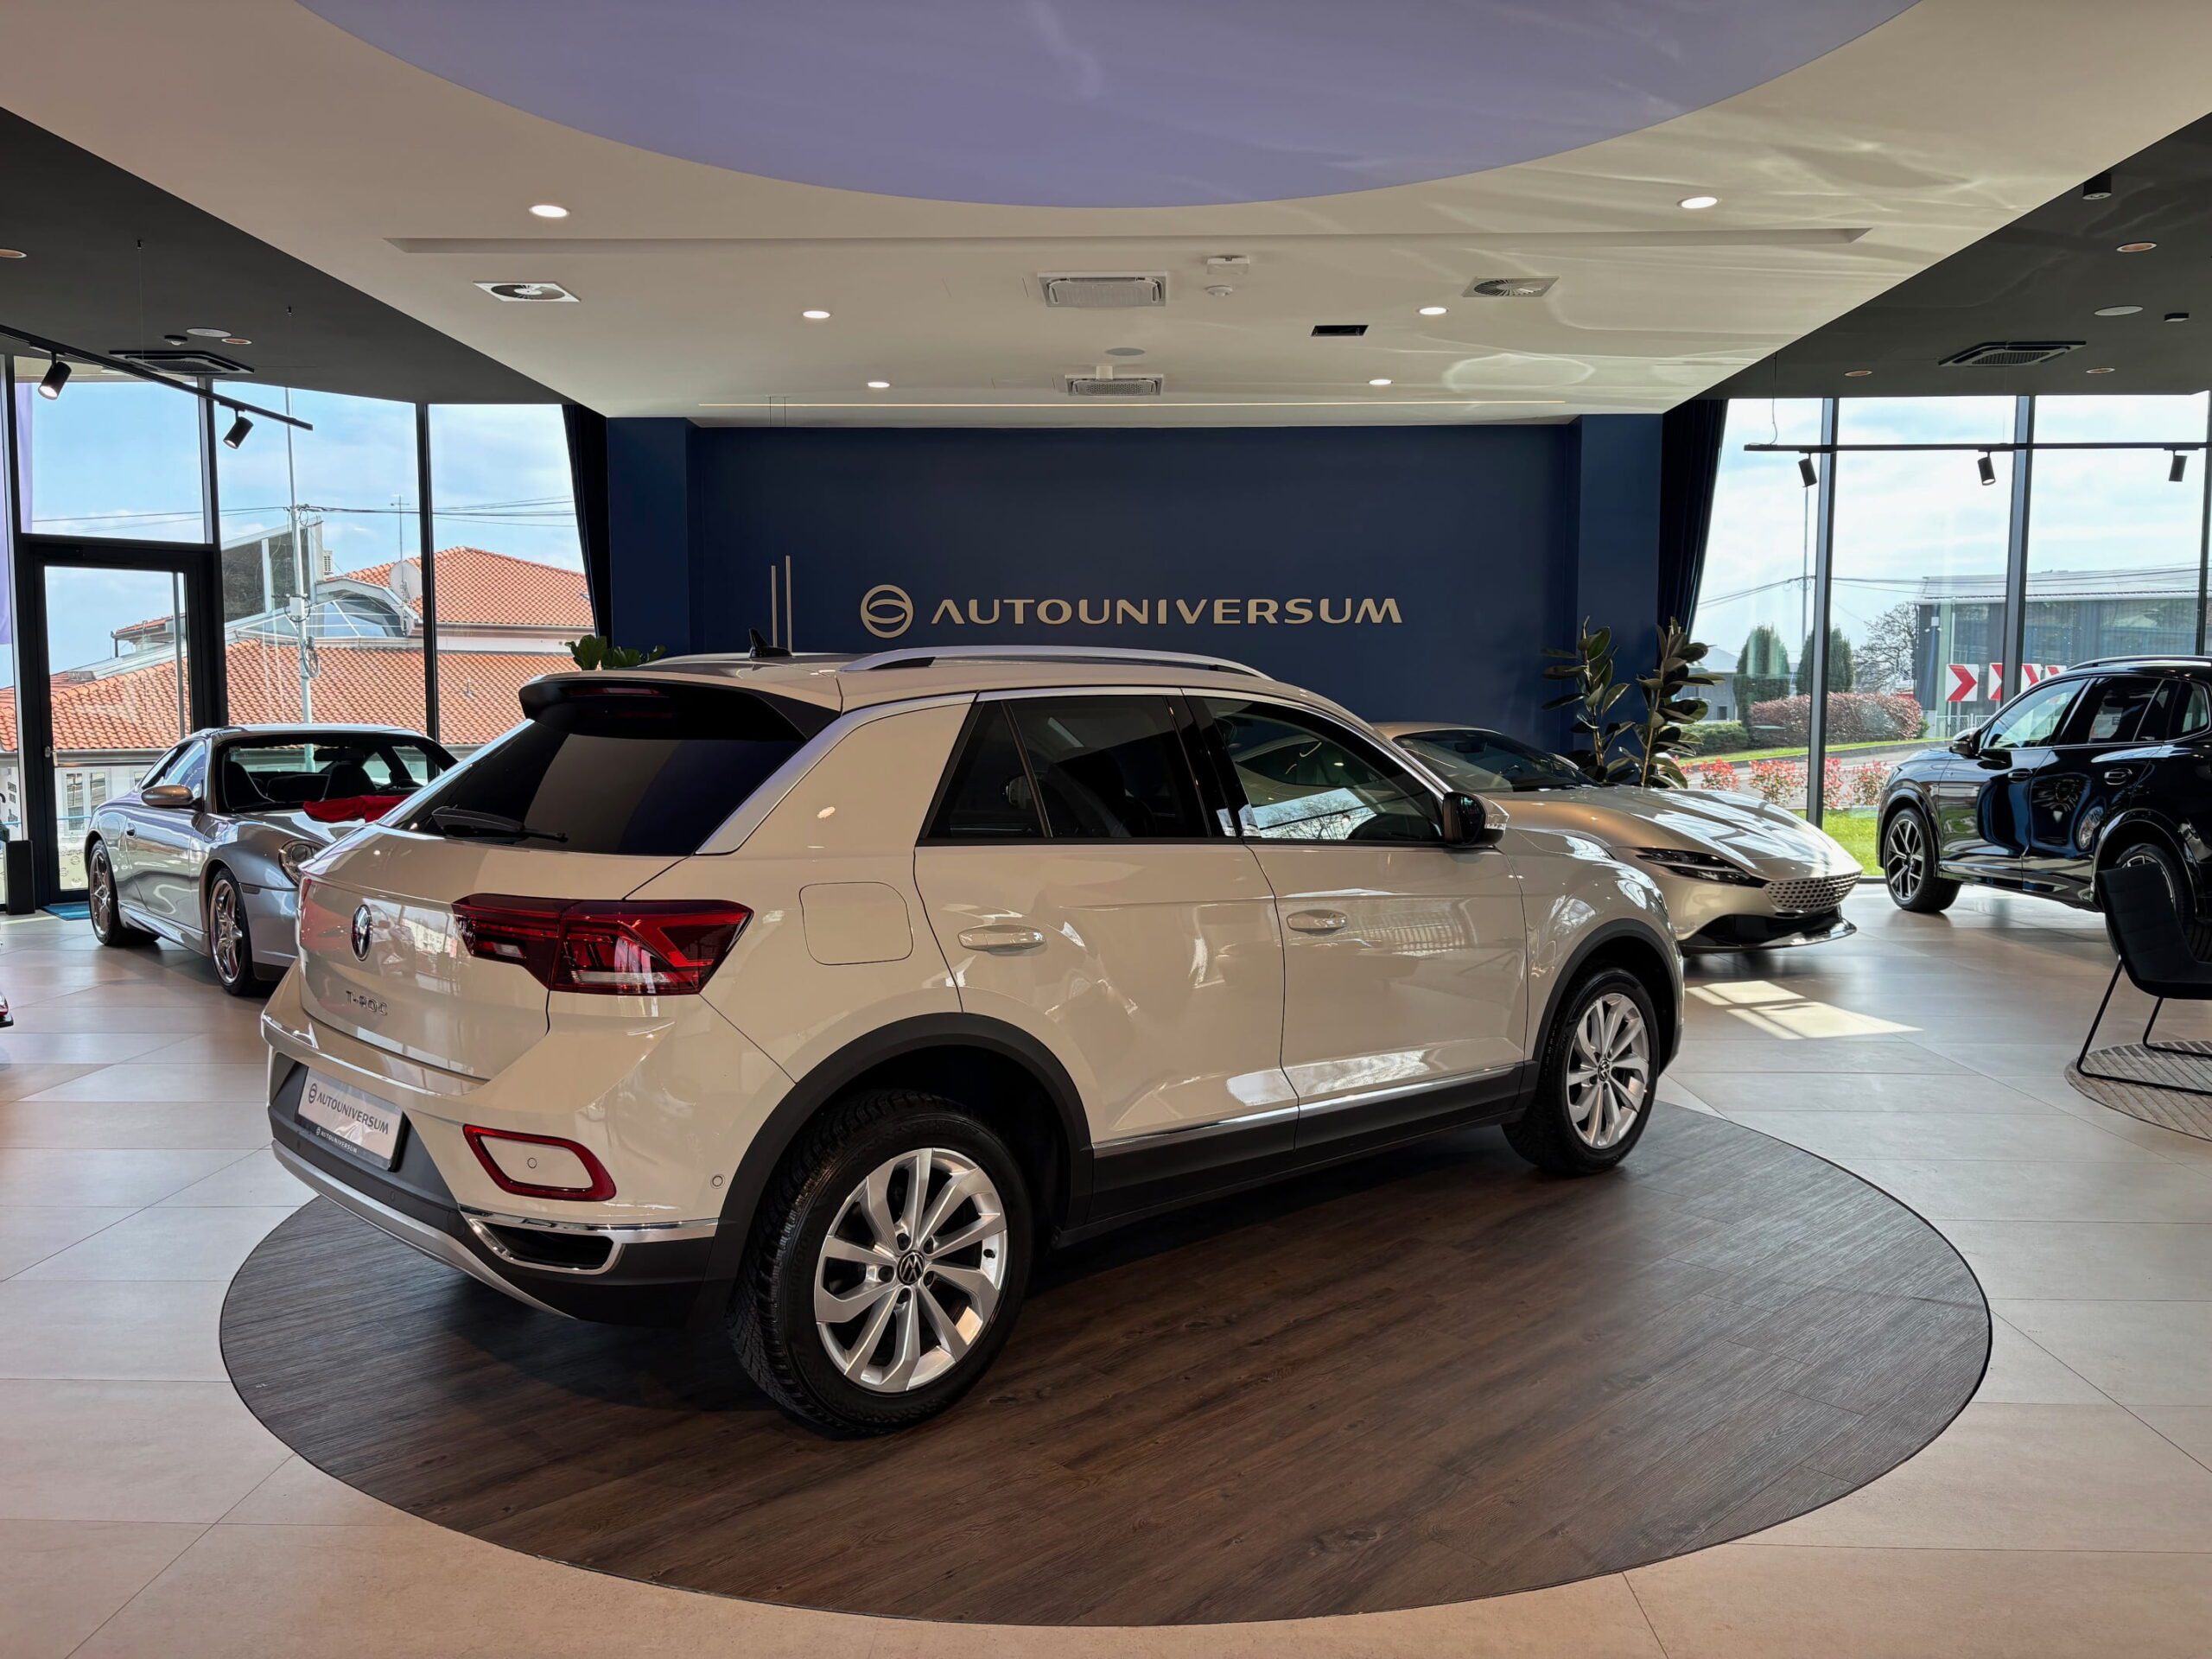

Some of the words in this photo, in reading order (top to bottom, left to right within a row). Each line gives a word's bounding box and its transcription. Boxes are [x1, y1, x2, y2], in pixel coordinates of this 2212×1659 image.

[931, 598, 1402, 626] AUTOUNIVERSUM
[346, 990, 388, 1016] T-ROC
[316, 1092, 389, 1135] AUTOUNIVERSUM
[321, 1132, 358, 1154] AUTOUNIVERSUM
